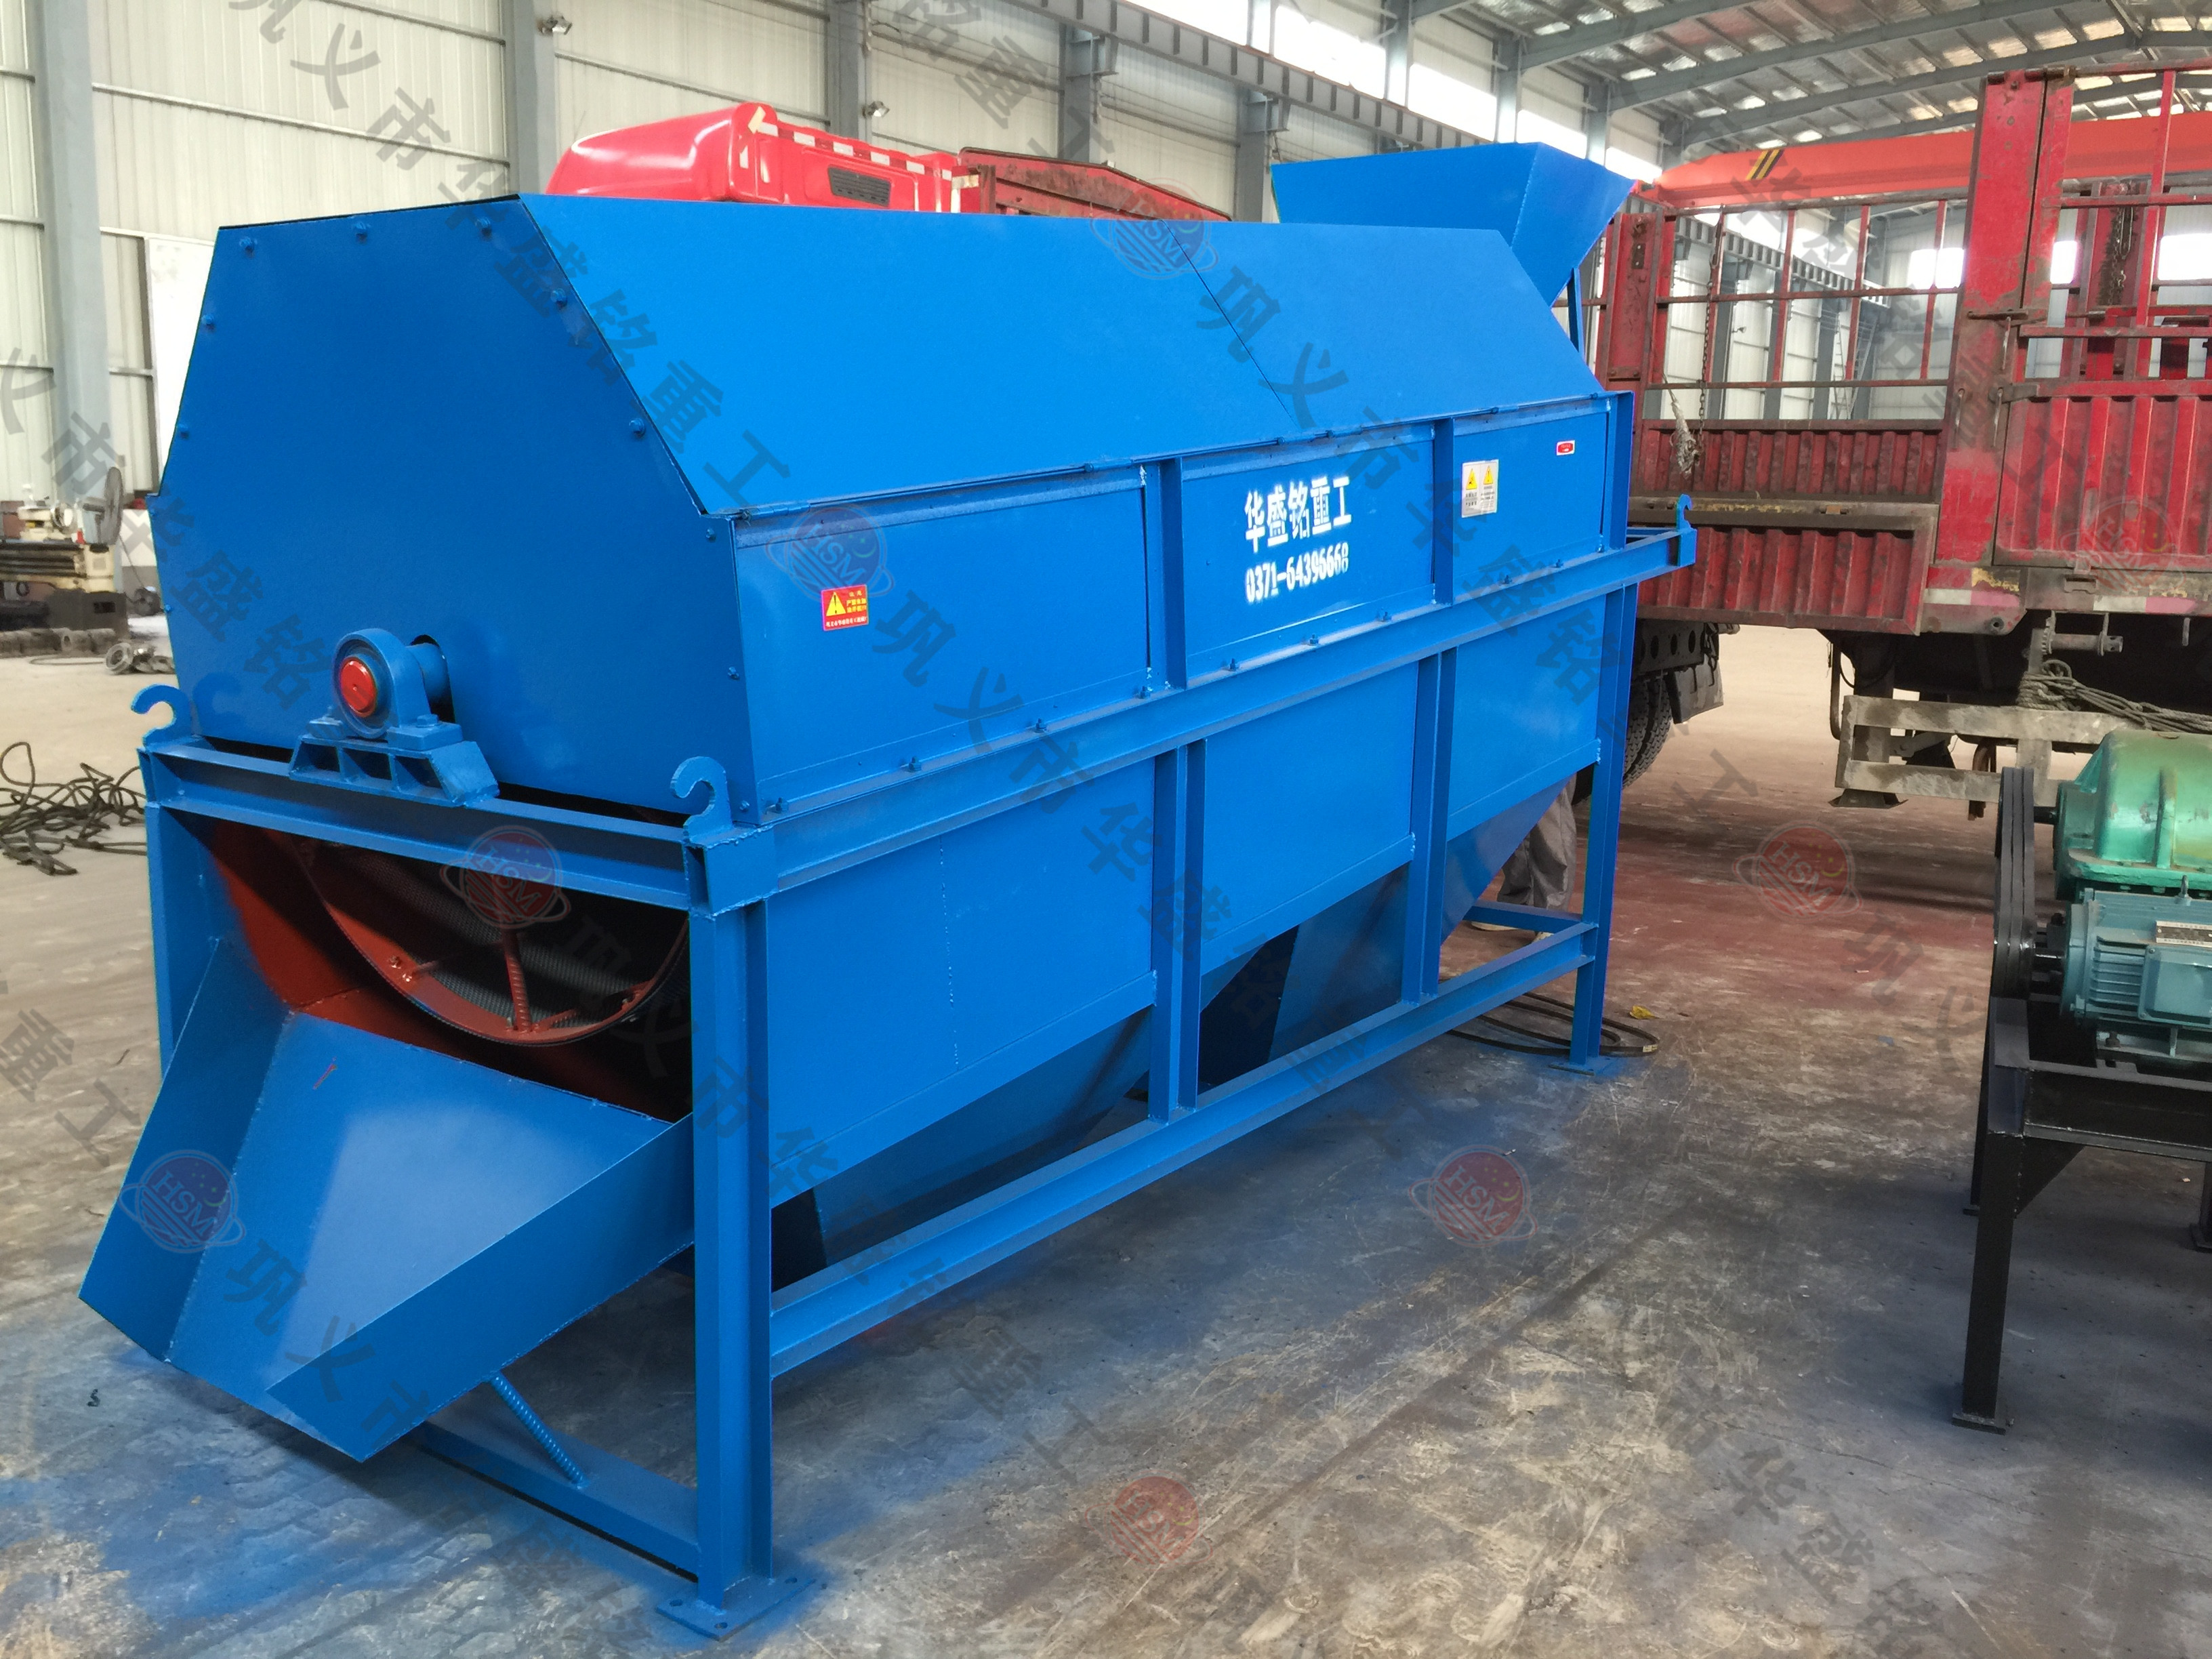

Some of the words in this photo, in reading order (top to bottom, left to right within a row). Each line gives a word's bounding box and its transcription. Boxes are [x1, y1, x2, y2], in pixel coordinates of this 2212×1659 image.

[1245, 476, 1352, 554] 华盛铭重工
[1246, 541, 1350, 605] 0371-64396668
